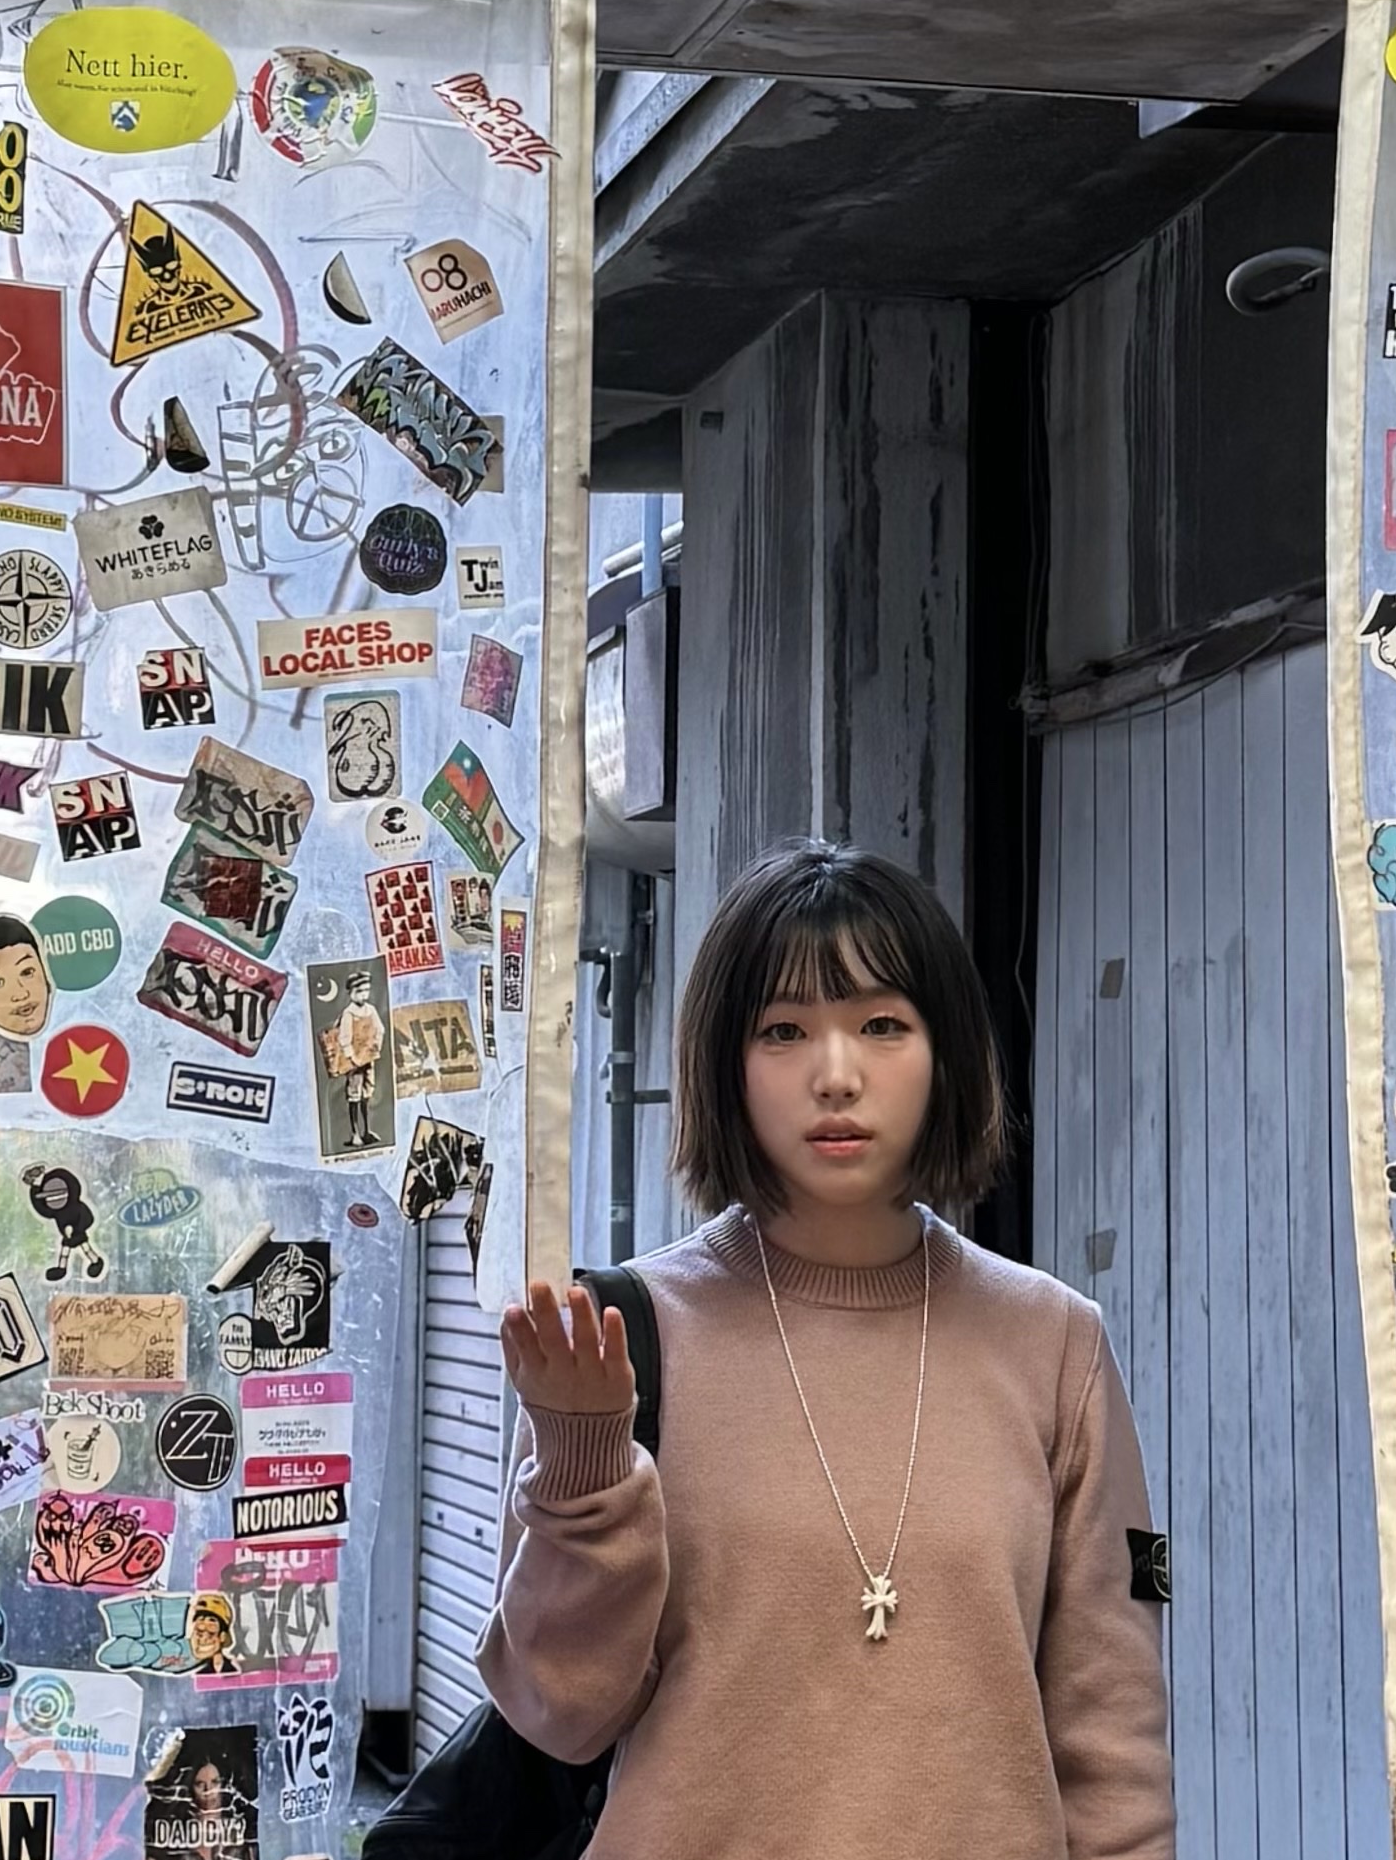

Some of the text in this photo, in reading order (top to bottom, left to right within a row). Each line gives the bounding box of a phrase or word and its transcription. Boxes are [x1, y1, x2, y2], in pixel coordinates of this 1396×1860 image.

[66, 48, 189, 80] Nett hier.
[94, 534, 213, 574] WHITEFLAG
[304, 620, 393, 650] FACES
[263, 641, 434, 678] LOCAL SHOP
[78, 927, 115, 954] CBD
[266, 1381, 325, 1399] HELLO
[268, 1461, 327, 1479] HELLO
[236, 1492, 341, 1537] NOTORIOUS
[57, 1722, 100, 1740] Orbit
[54, 1736, 130, 1757] musicians
